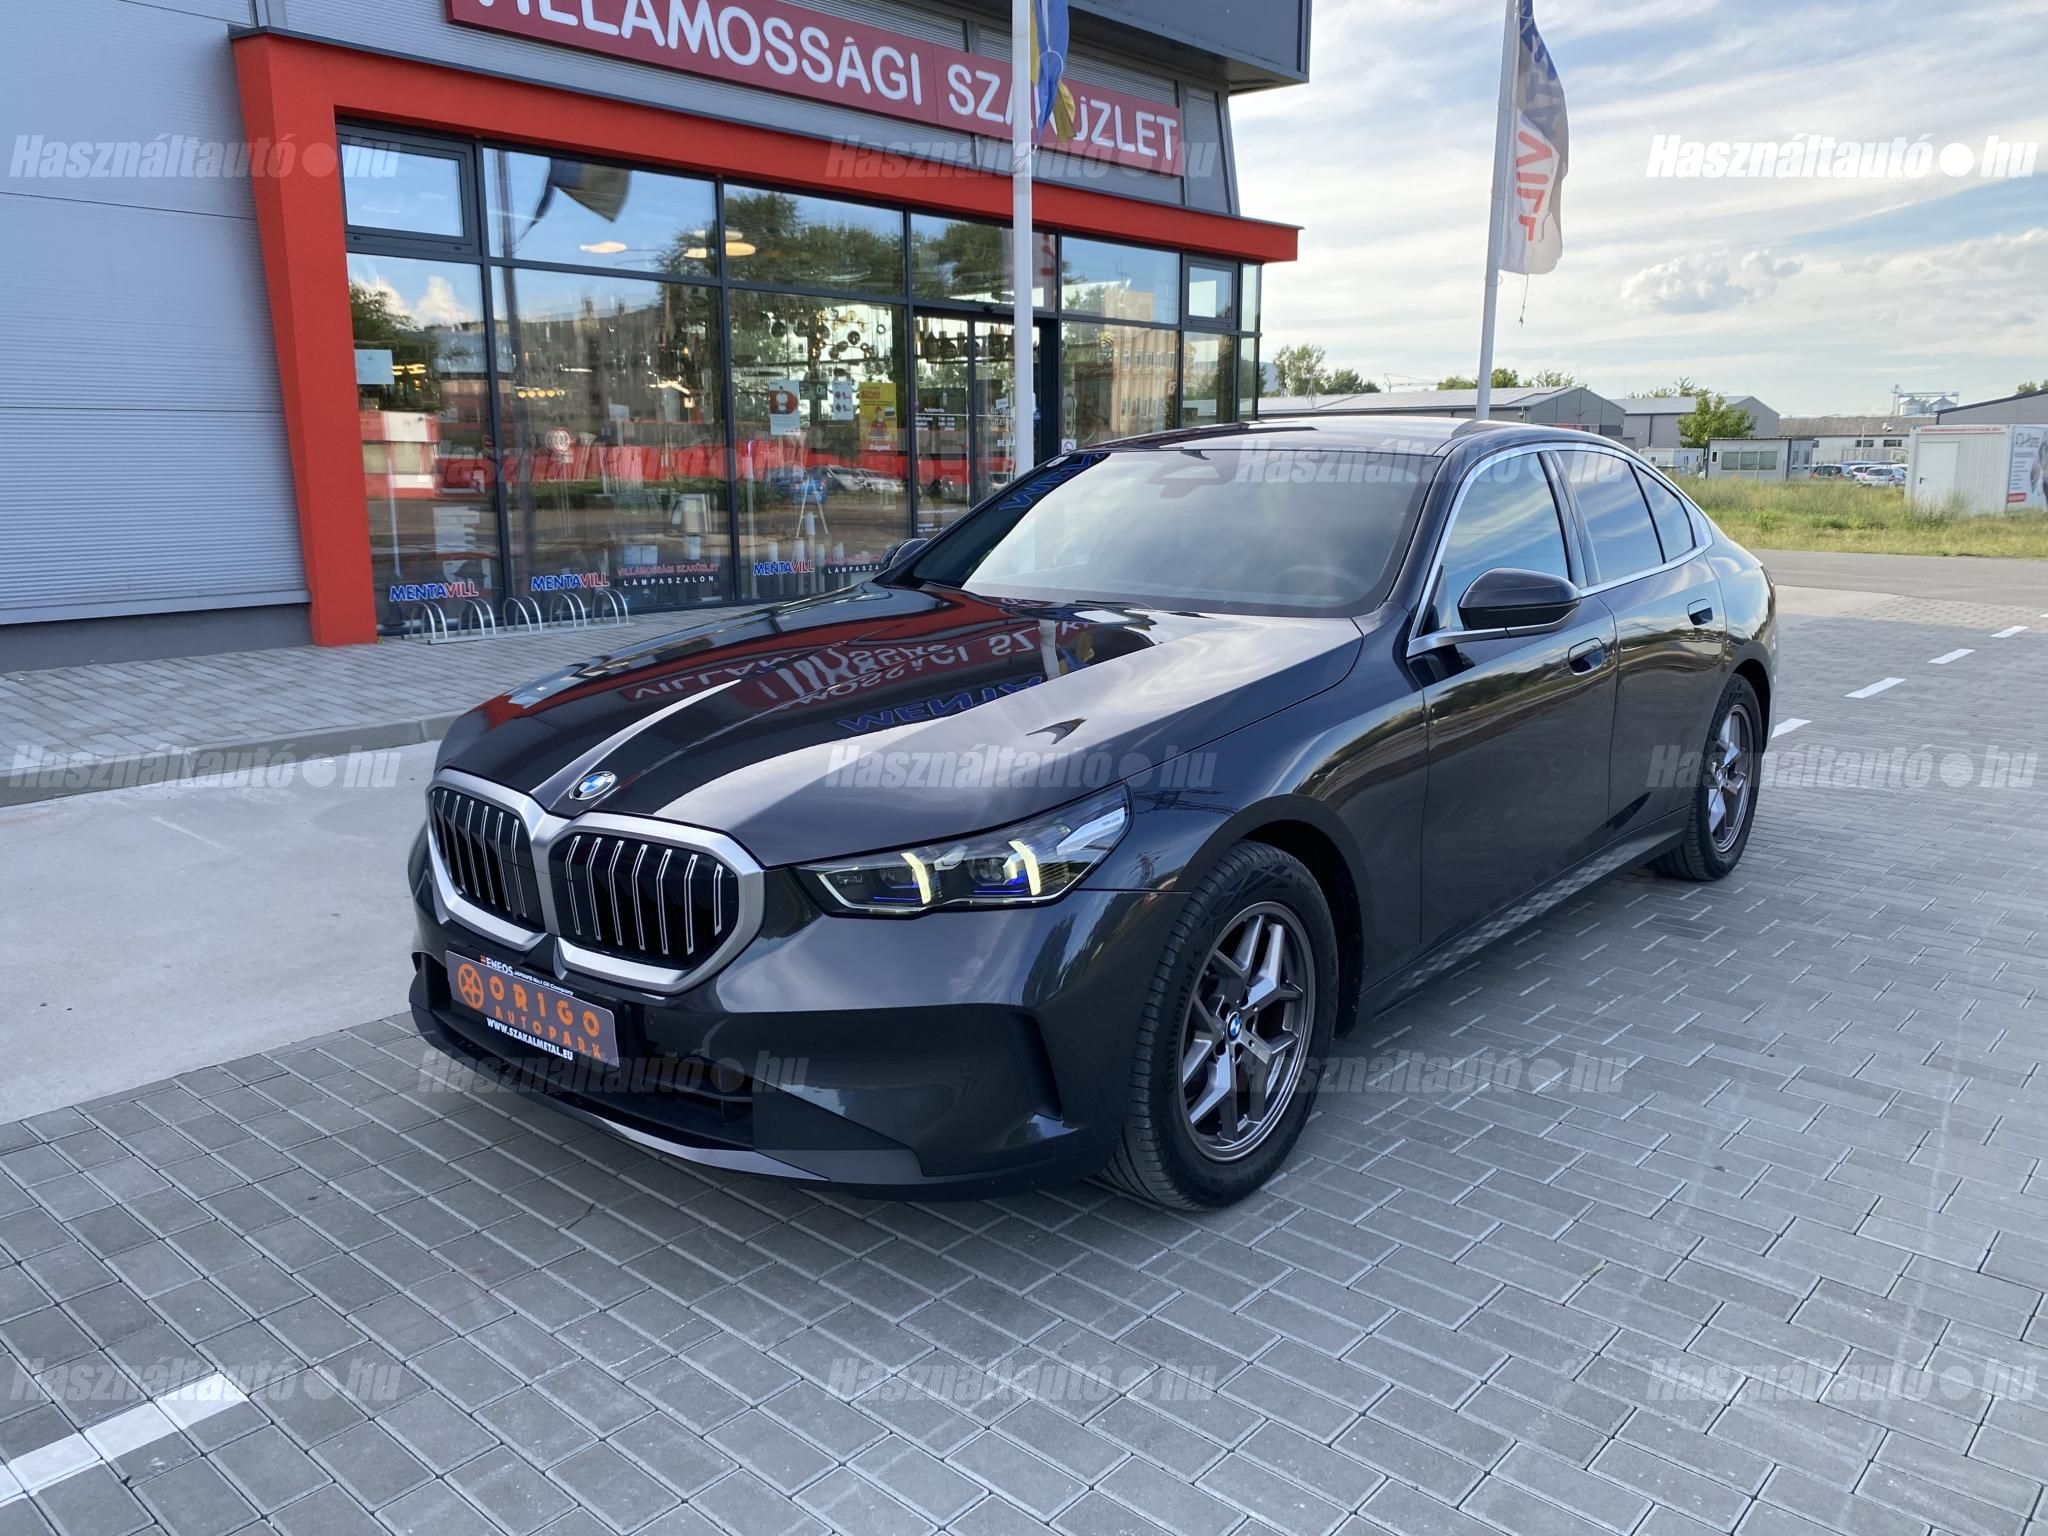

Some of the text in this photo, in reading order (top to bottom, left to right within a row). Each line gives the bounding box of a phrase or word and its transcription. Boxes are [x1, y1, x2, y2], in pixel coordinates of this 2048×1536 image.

[478, 0, 922, 105] LAMOSSÁGI
[530, 572, 610, 591] MENTAVILL
[623, 574, 714, 587] LÁMPASZALON
[753, 560, 814, 576] MENTAVILL
[389, 581, 479, 602] MENTAVILL
[486, 957, 514, 976] ENEOS
[550, 983, 574, 996] Company
[489, 975, 600, 1038] ORIGO
[486, 1017, 574, 1061] WWW.SZAKALMETAL.EU
[495, 1005, 601, 1057] AUTOPARK
